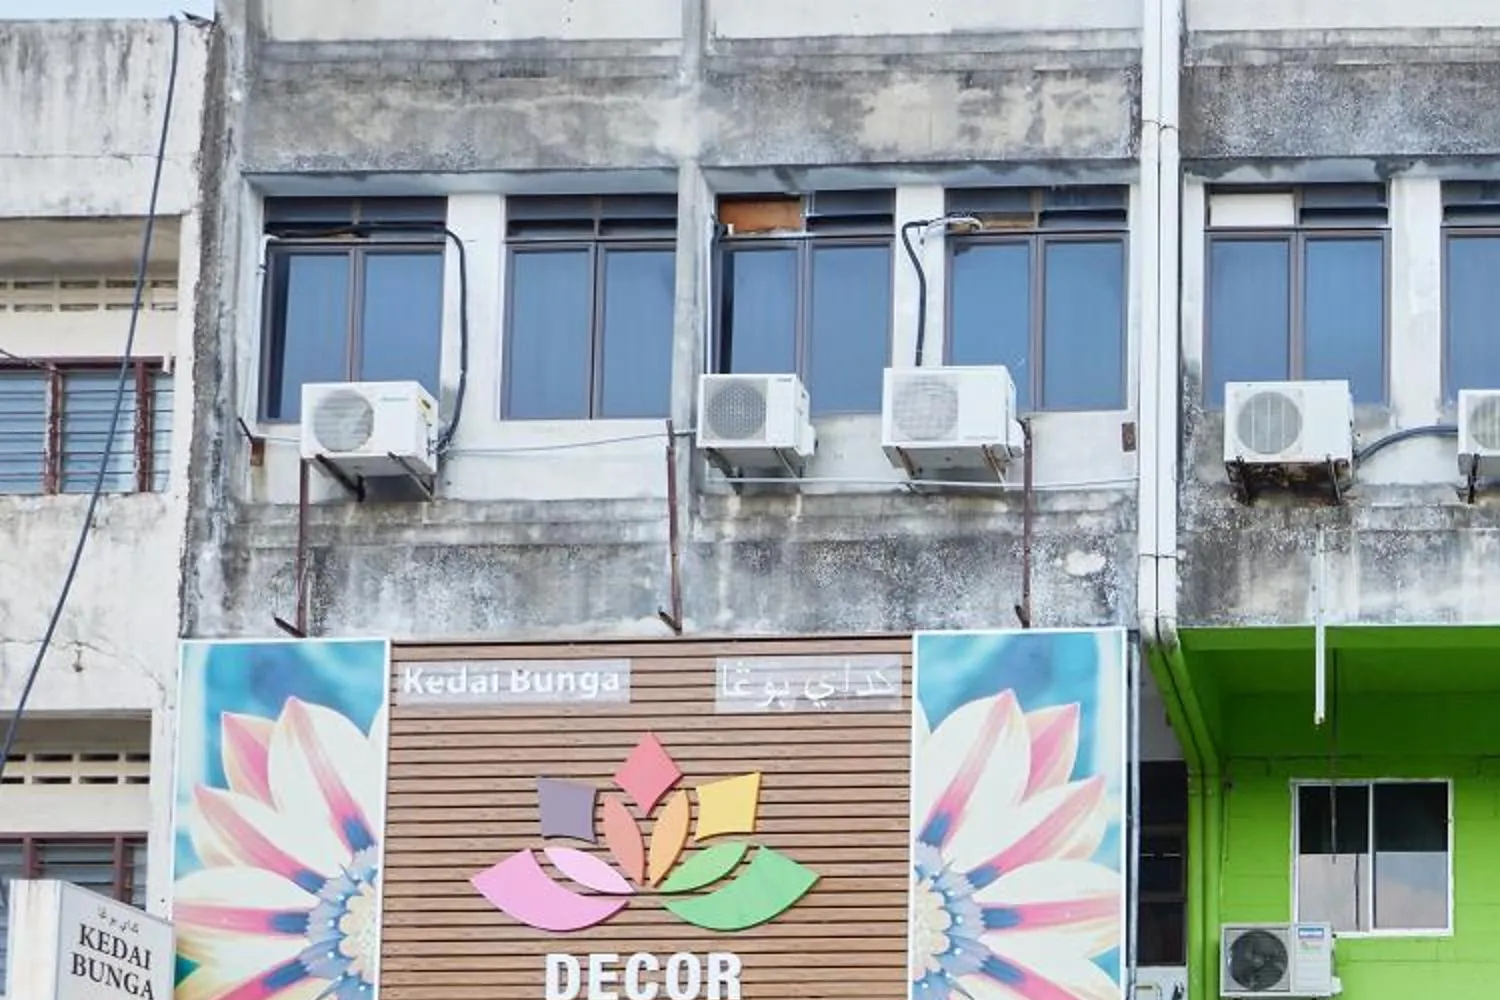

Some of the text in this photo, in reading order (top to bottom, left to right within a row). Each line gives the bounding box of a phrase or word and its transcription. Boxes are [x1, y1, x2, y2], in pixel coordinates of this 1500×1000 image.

[403, 667, 620, 699] Kedai Bunga
[79, 923, 153, 970] KEDAI
[71, 951, 155, 1000] BUNGA
